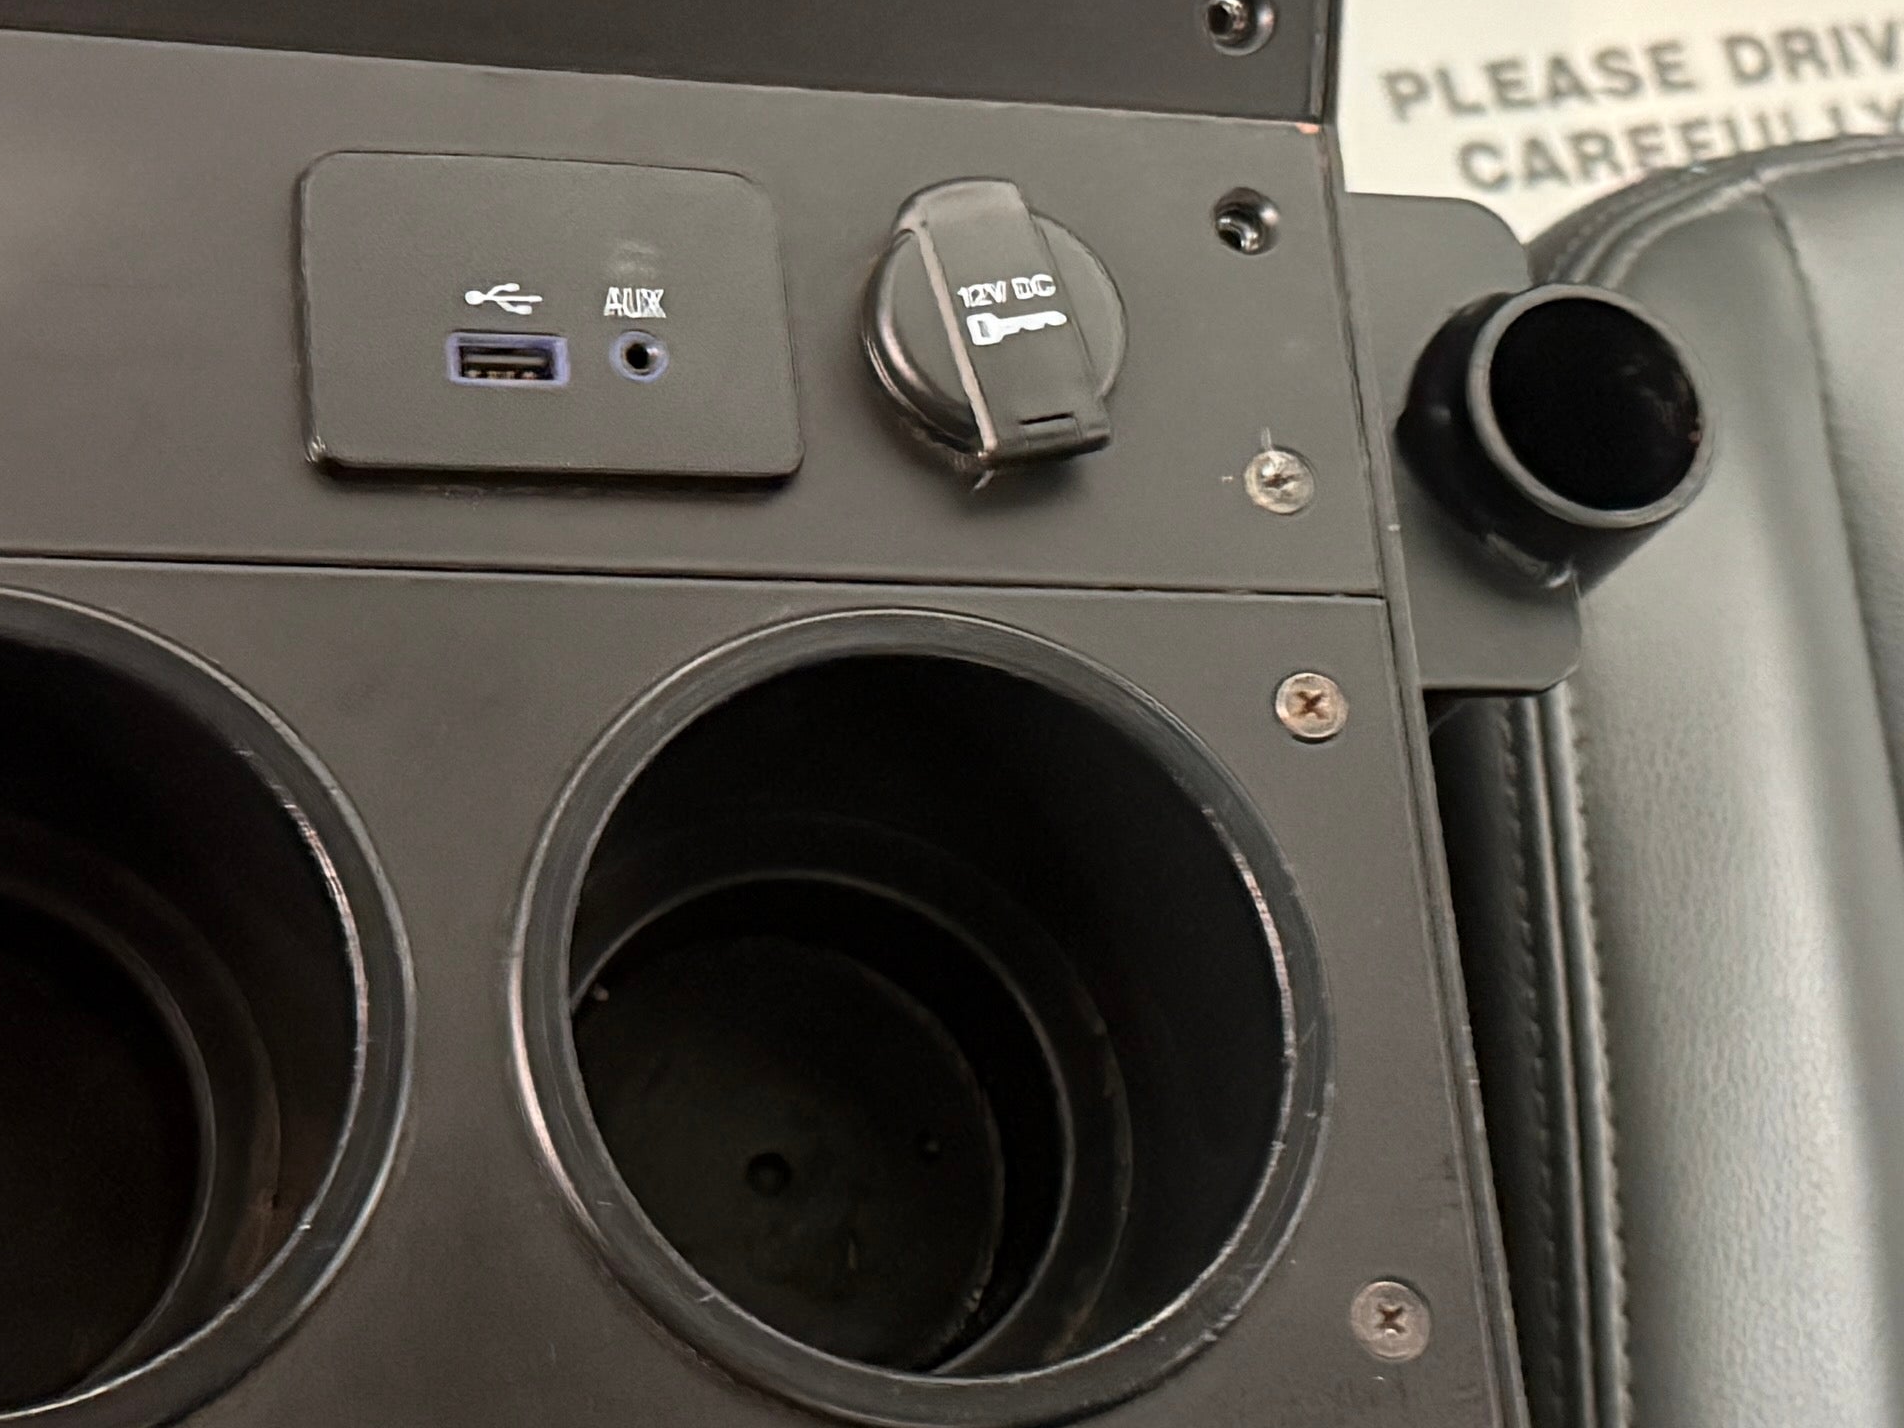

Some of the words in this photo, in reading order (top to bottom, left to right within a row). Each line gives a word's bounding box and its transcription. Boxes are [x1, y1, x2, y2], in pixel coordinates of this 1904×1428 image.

[1380, 38, 1698, 124] PLEASE
[603, 286, 667, 318] AUX
[957, 280, 1007, 308] 12V
[1011, 273, 1056, 300] DC
